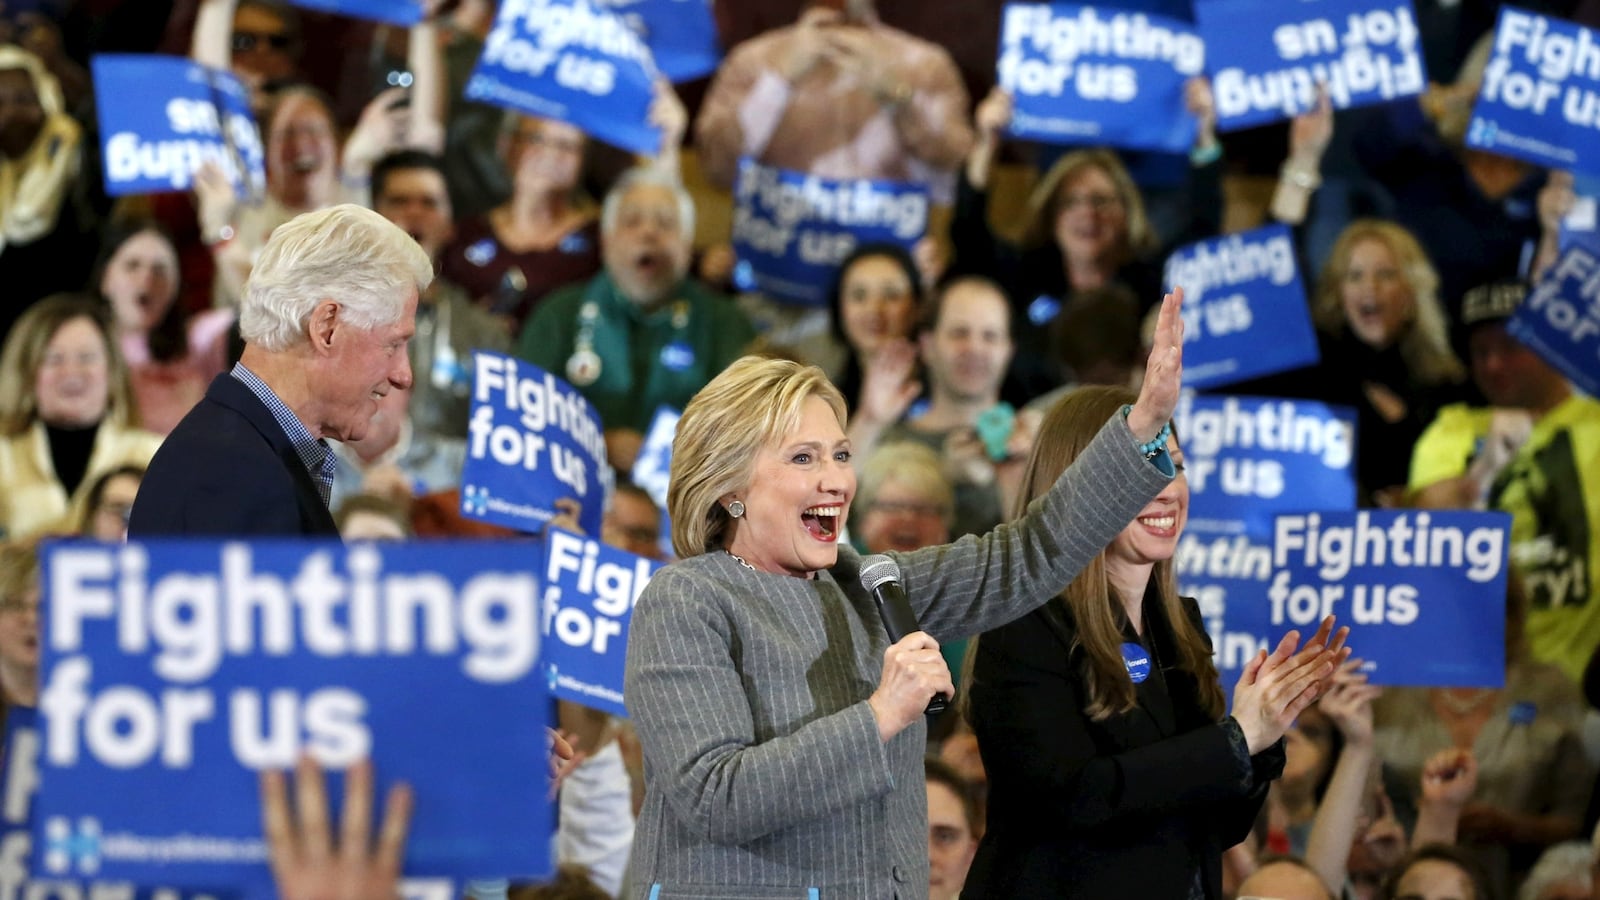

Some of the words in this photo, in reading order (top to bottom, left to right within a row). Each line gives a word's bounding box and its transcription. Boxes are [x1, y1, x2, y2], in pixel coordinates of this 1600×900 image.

[483, 32, 558, 78] for
[556, 53, 617, 96] us
[1004, 5, 1205, 75] Fighting
[1273, 19, 1337, 60] us
[1342, 6, 1418, 52] for
[1497, 9, 1600, 82] Figh
[998, 47, 1073, 97] for
[1075, 63, 1138, 103] us
[1484, 57, 1561, 115] for
[733, 208, 796, 257] for
[737, 158, 929, 240] Fighting
[469, 405, 545, 471] for
[550, 442, 587, 497] us
[1178, 387, 1354, 469] ighting
[1221, 457, 1285, 499] us
[1274, 510, 1505, 583] Fighting
[48, 542, 540, 683] Fighting
[543, 585, 622, 655] for
[1268, 570, 1345, 626] for
[1352, 584, 1419, 626] us
[40, 655, 215, 769] for
[229, 685, 373, 771] us
